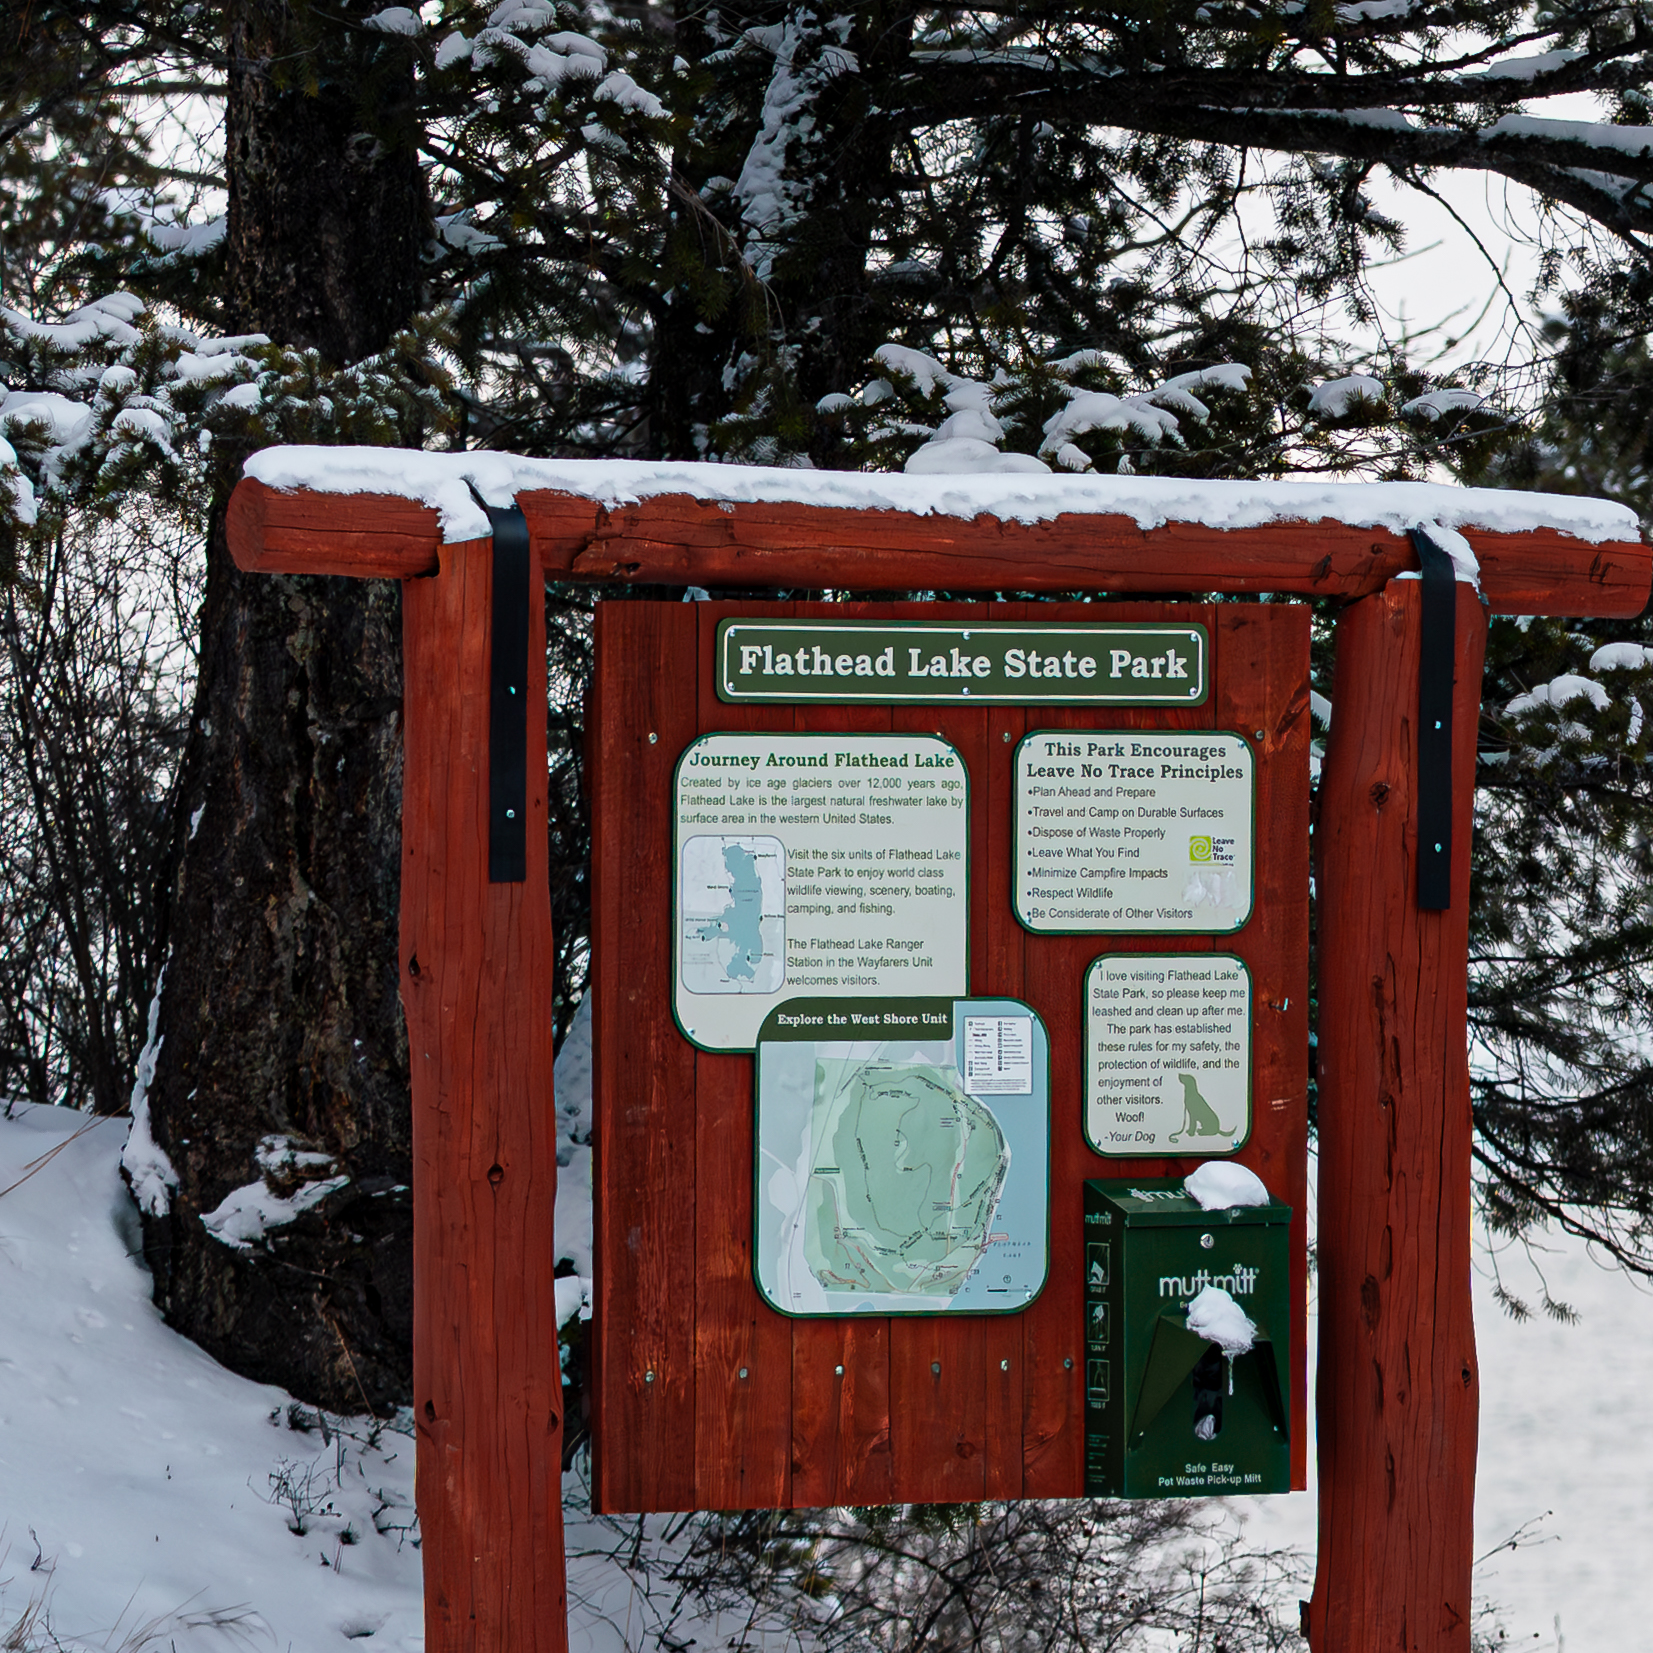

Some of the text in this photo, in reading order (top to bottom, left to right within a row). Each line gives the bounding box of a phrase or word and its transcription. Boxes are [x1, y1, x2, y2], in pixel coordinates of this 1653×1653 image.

[739, 646, 1188, 678] Flathead Lake State Park
[1044, 742, 1226, 761] This Park Encourages
[689, 752, 954, 771] Journey Around Flathead Lake
[1027, 763, 1244, 783] Leave No Trace Principles
[680, 776, 963, 792] Created by ice age glaciers over 12,000 years ago,
[1033, 786, 1156, 800] Plan Ahead and Prepare
[680, 794, 964, 809] Flathead Lake is the largest natural freshwater lake by
[680, 813, 894, 824] surface area in the western United States.
[1033, 806, 1224, 820] Travel and Camp on Durable Surfaces
[1032, 826, 1166, 841] Dispose of Waste Properly
[1212, 837, 1235, 845] Leave
[787, 849, 810, 860] Visit
[812, 849, 829, 860] the
[831, 849, 846, 860] six
[848, 849, 873, 860] units
[876, 849, 886, 860] of
[889, 849, 933, 860] Flathead
[936, 849, 961, 860] Lake
[1032, 847, 1140, 858] Leave What You Find
[1212, 845, 1224, 853] No
[1213, 853, 1234, 861] Trace
[787, 867, 944, 881] State Park to enjoy world class
[1032, 867, 1168, 881] Minimize Campfire Impacts
[787, 884, 956, 898] wildlife viewing, scenery, boating,
[1032, 887, 1113, 900] Respect Wildlife
[787, 902, 896, 916] camping, and fishing.
[1032, 907, 1193, 919] Be Considerate of Other Visitors
[787, 938, 925, 952] The Flathead Lake Ranger
[787, 956, 933, 970] Station in the Wayfarers Unit
[786, 974, 880, 986] welcomes visitors.
[1106, 970, 1128, 981] love
[1130, 970, 1165, 984] visiting
[1168, 970, 1212, 981] Flathead
[1214, 970, 1239, 981] Lake
[1093, 987, 1246, 1001] State Park, so please keep me
[1092, 1005, 1245, 1018] leashed and clean up after me.
[778, 1013, 948, 1028] Explore the West Shore Unit
[1107, 1023, 1232, 1036] The park has established
[1098, 1040, 1241, 1054] these rules for my safety, the
[1098, 1058, 1240, 1072] protection of wildlife, and the
[1098, 1076, 1163, 1090] enjoyment of
[1097, 1094, 1164, 1105] other visitors.
[1115, 1111, 1145, 1123] Woof!
[1134, 1131, 1156, 1144] Dog
